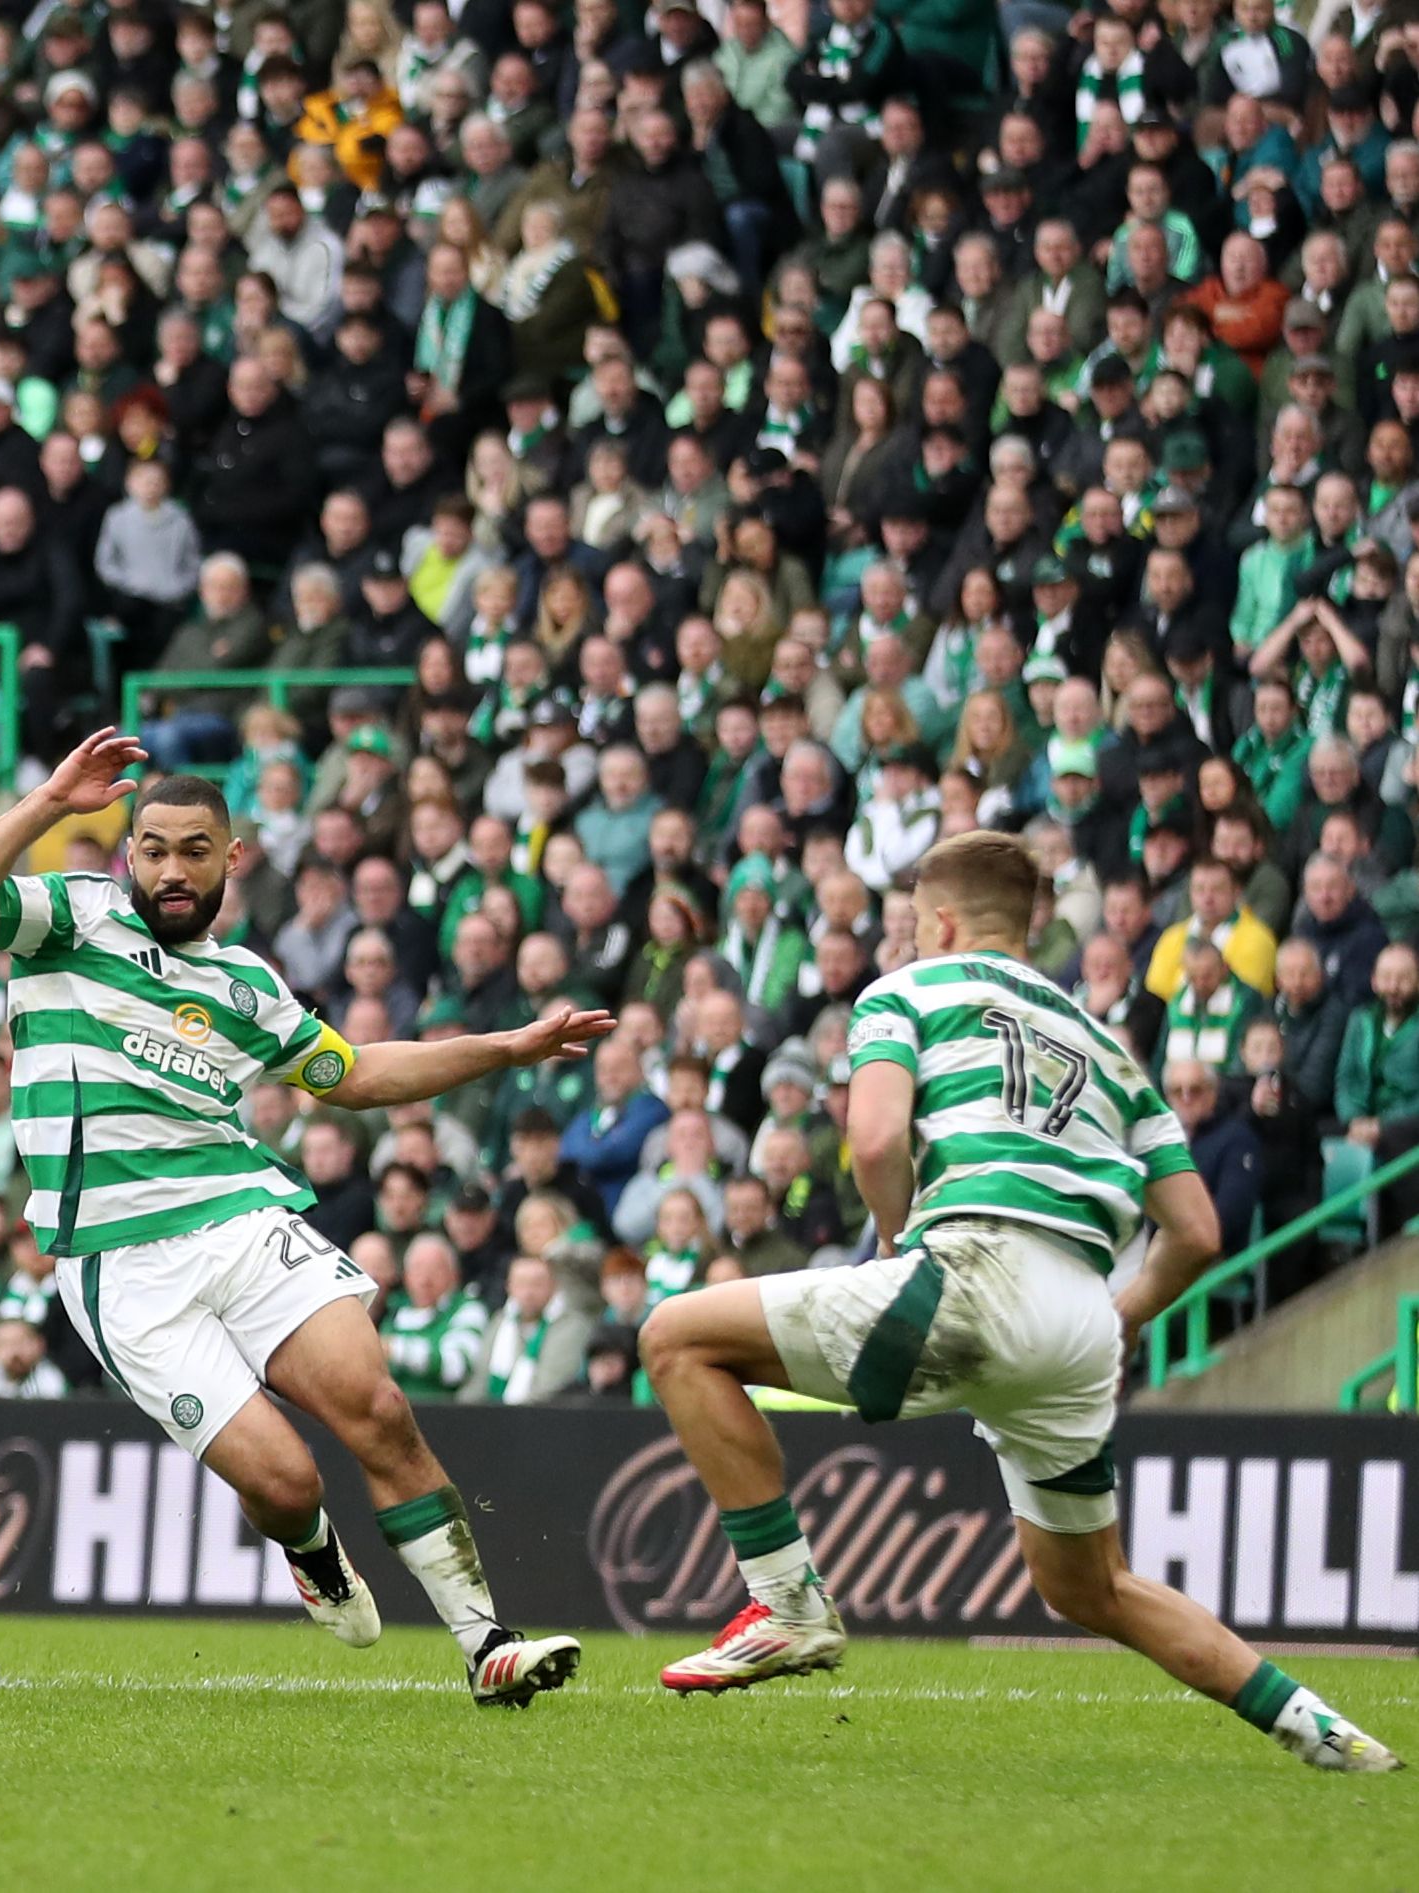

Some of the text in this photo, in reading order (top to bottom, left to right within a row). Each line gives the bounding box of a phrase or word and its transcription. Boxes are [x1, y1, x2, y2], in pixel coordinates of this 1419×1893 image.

[122, 1029, 228, 1097] dafabet
[981, 1008, 1090, 1139] 17
[264, 1218, 337, 1270] 20
[1130, 1456, 1419, 1632] HILL
